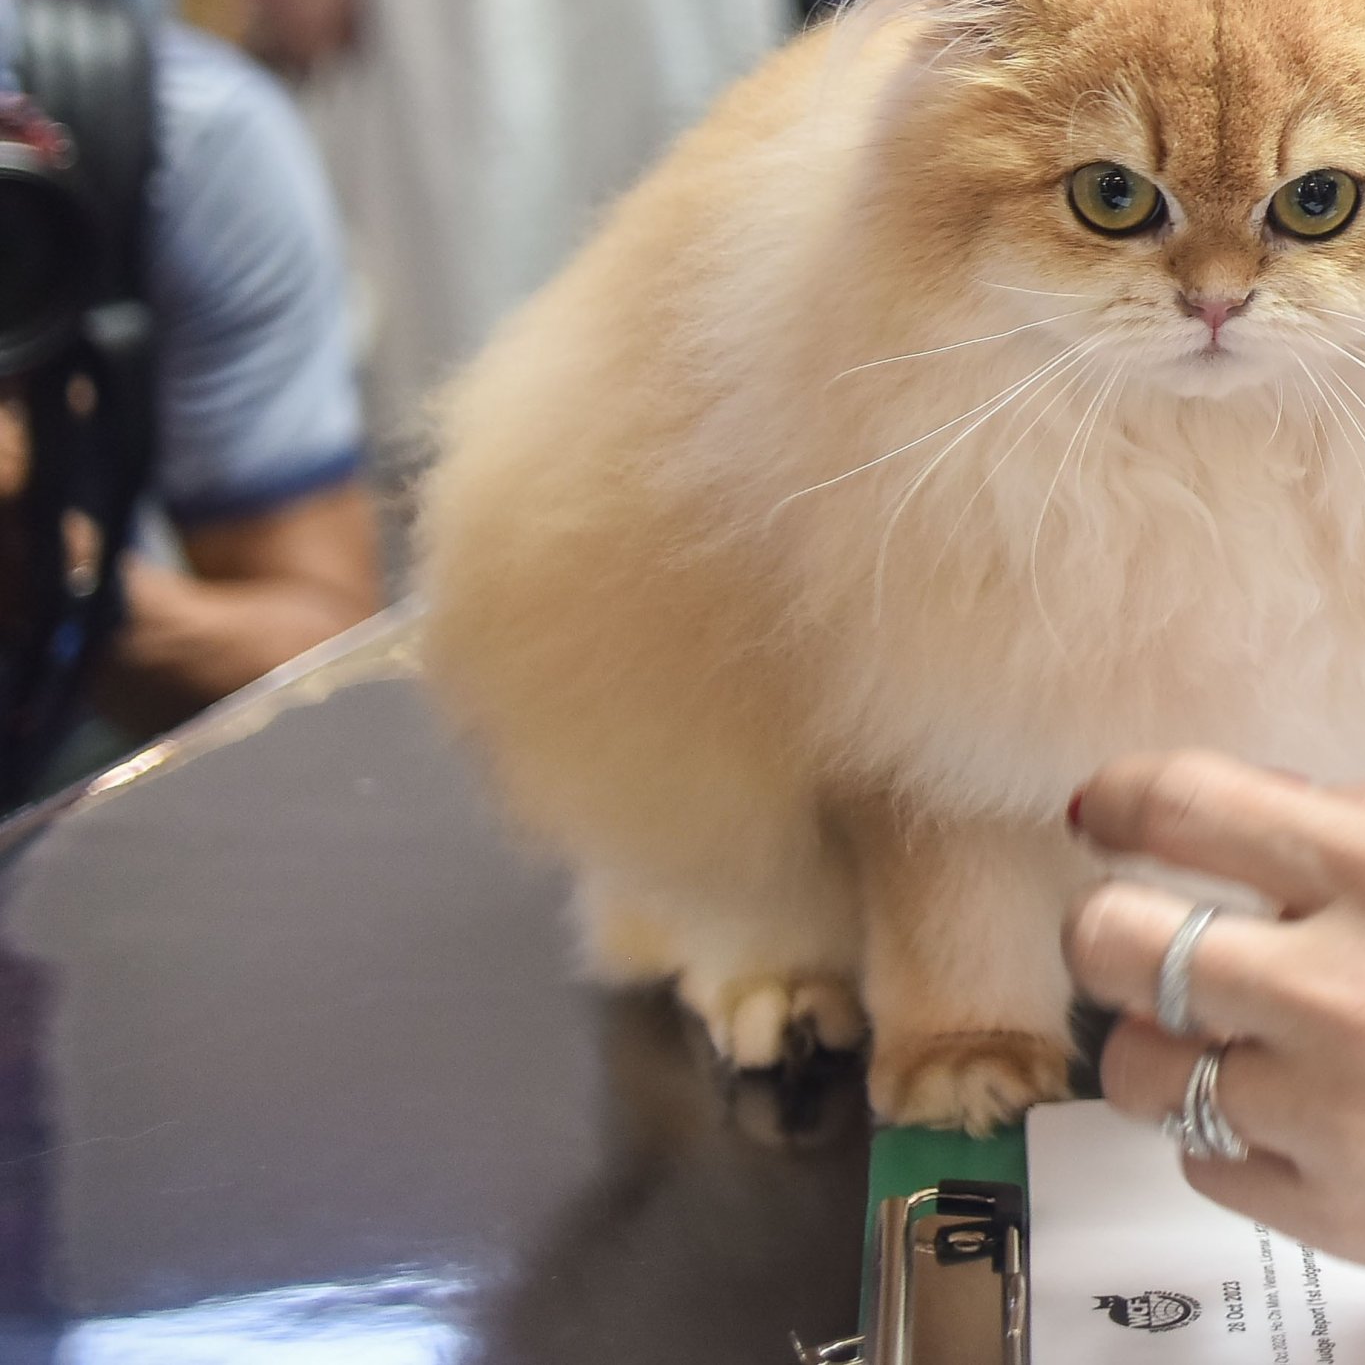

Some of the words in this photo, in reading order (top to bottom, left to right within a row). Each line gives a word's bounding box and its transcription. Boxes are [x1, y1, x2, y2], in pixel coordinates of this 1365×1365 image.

[1222, 1281, 1242, 1302] 2023
[1305, 1289, 1328, 1306] (1st
[1126, 1295, 1151, 1328] WCF
[1226, 1303, 1244, 1320] Oct
[1309, 1307, 1332, 1336] Report
[1228, 1321, 1246, 1332] 28
[1315, 1336, 1336, 1365] Judge
